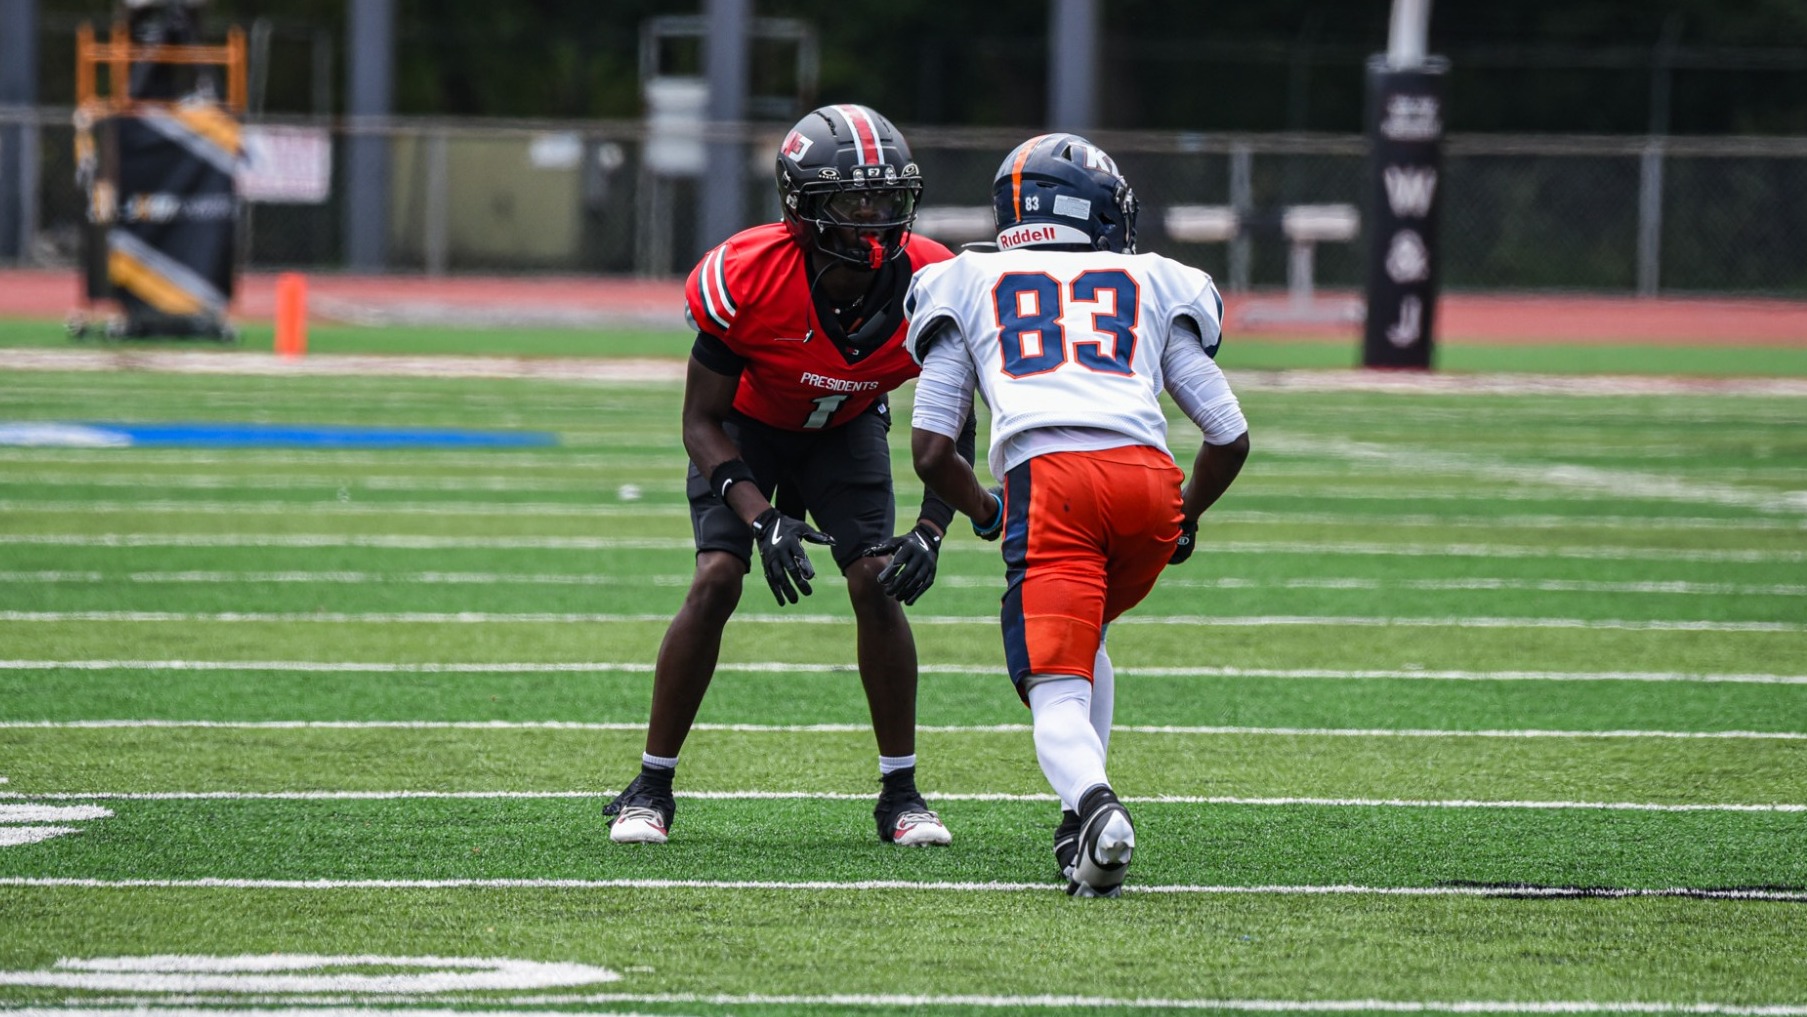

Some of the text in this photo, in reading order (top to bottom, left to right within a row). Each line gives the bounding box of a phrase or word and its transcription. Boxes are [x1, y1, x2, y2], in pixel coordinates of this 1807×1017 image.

[1025, 196, 1040, 211] 83
[1000, 227, 1055, 248] Riddell
[991, 269, 1141, 379] 83
[800, 371, 879, 392] PRESIDENTS
[802, 394, 849, 429] 1
